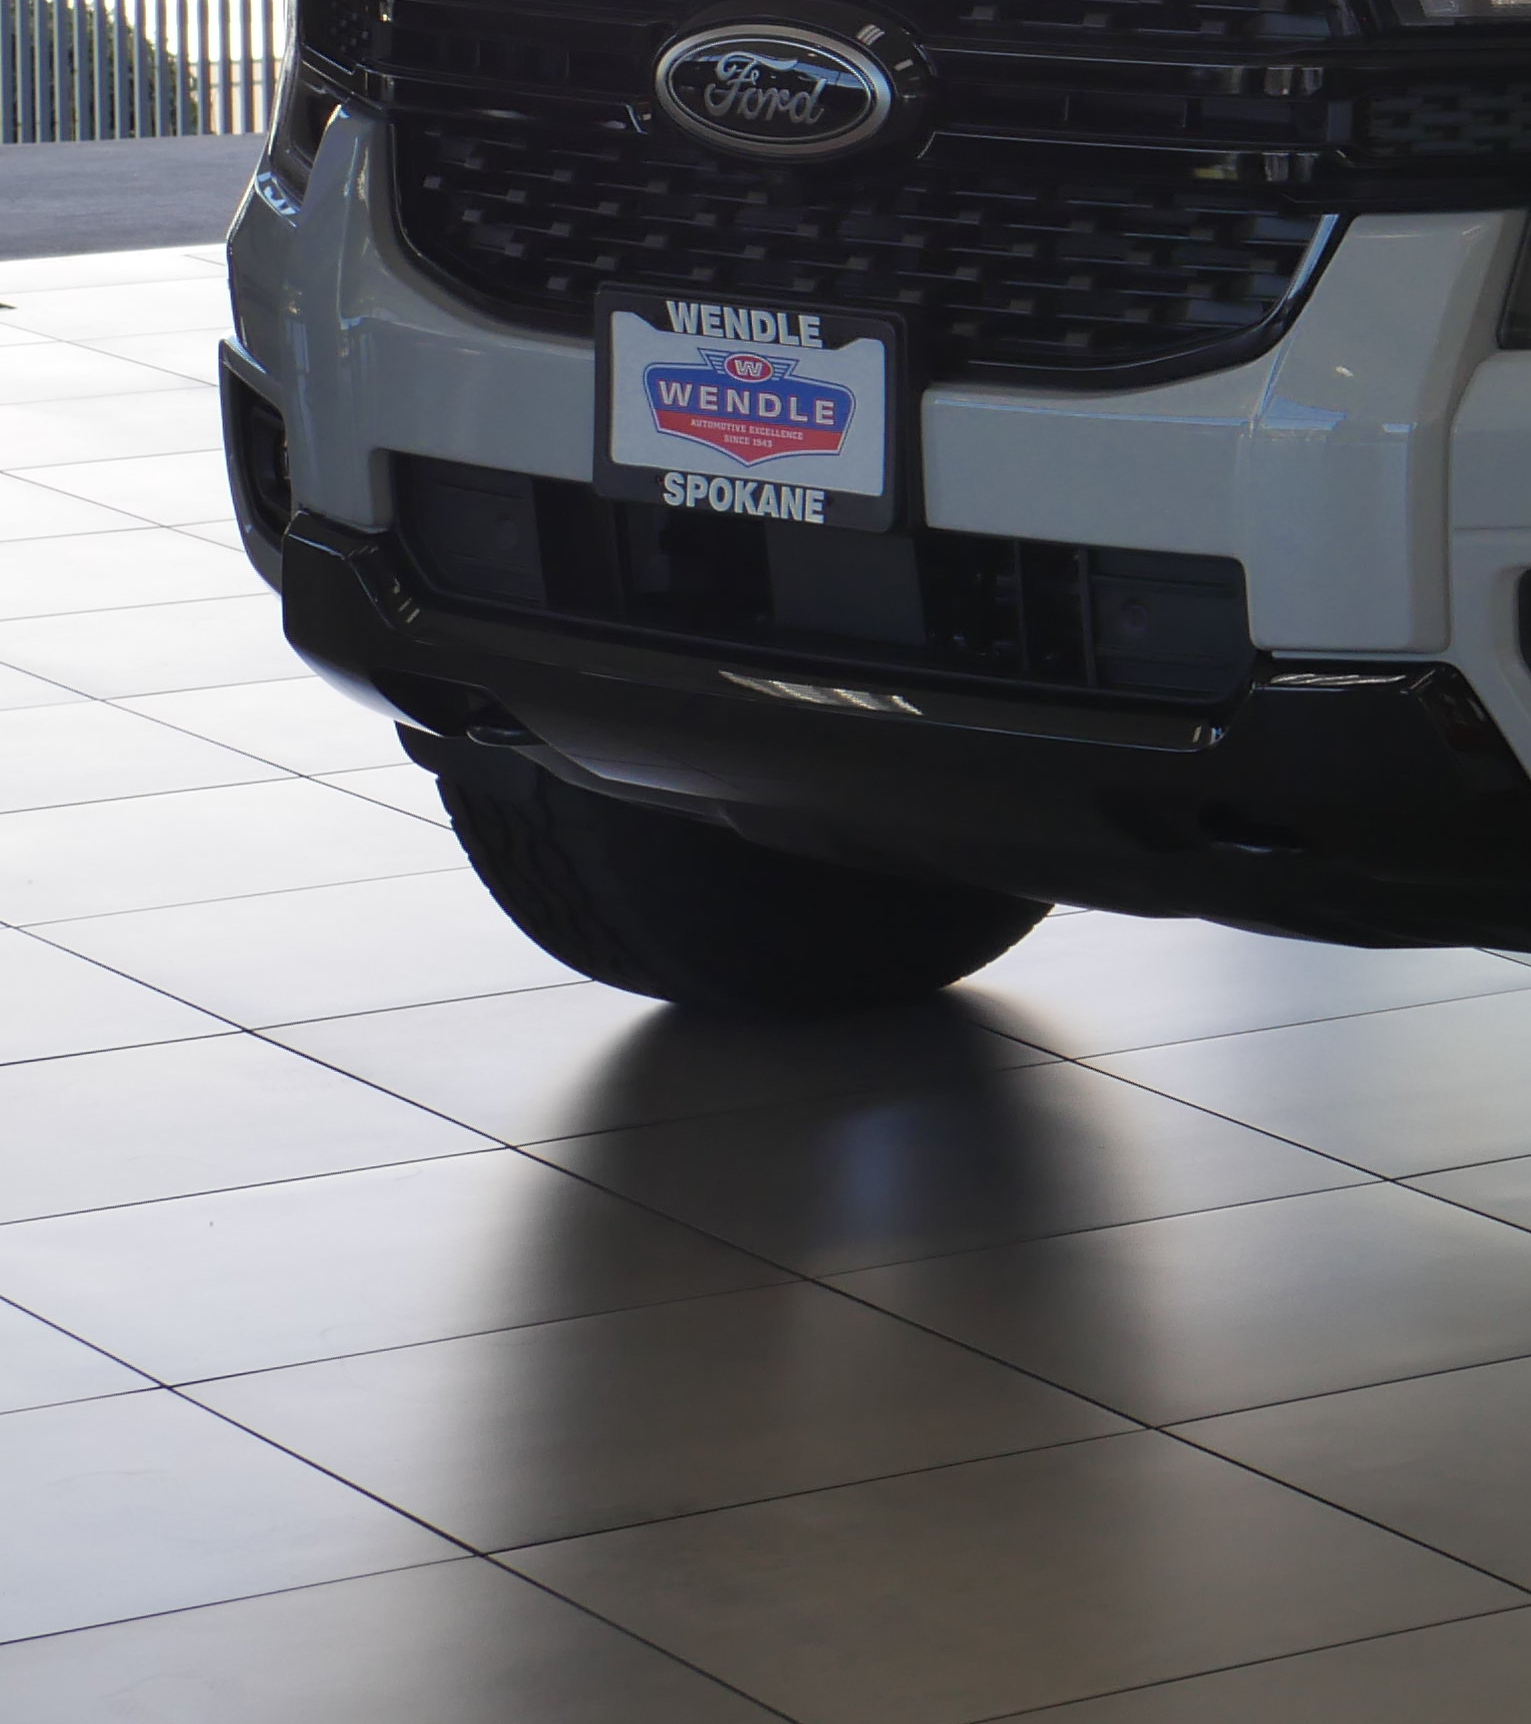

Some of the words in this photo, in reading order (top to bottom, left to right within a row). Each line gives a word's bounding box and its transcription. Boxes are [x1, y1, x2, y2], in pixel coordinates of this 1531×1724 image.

[704, 51, 829, 124] Ford
[666, 300, 824, 349] WENDLE
[658, 379, 835, 425] WENDLE
[691, 418, 747, 433] AUTOMOTIVE
[749, 425, 804, 440] EXCELLENCE
[724, 434, 750, 445] SINCE
[663, 471, 825, 524] SPOKANE
